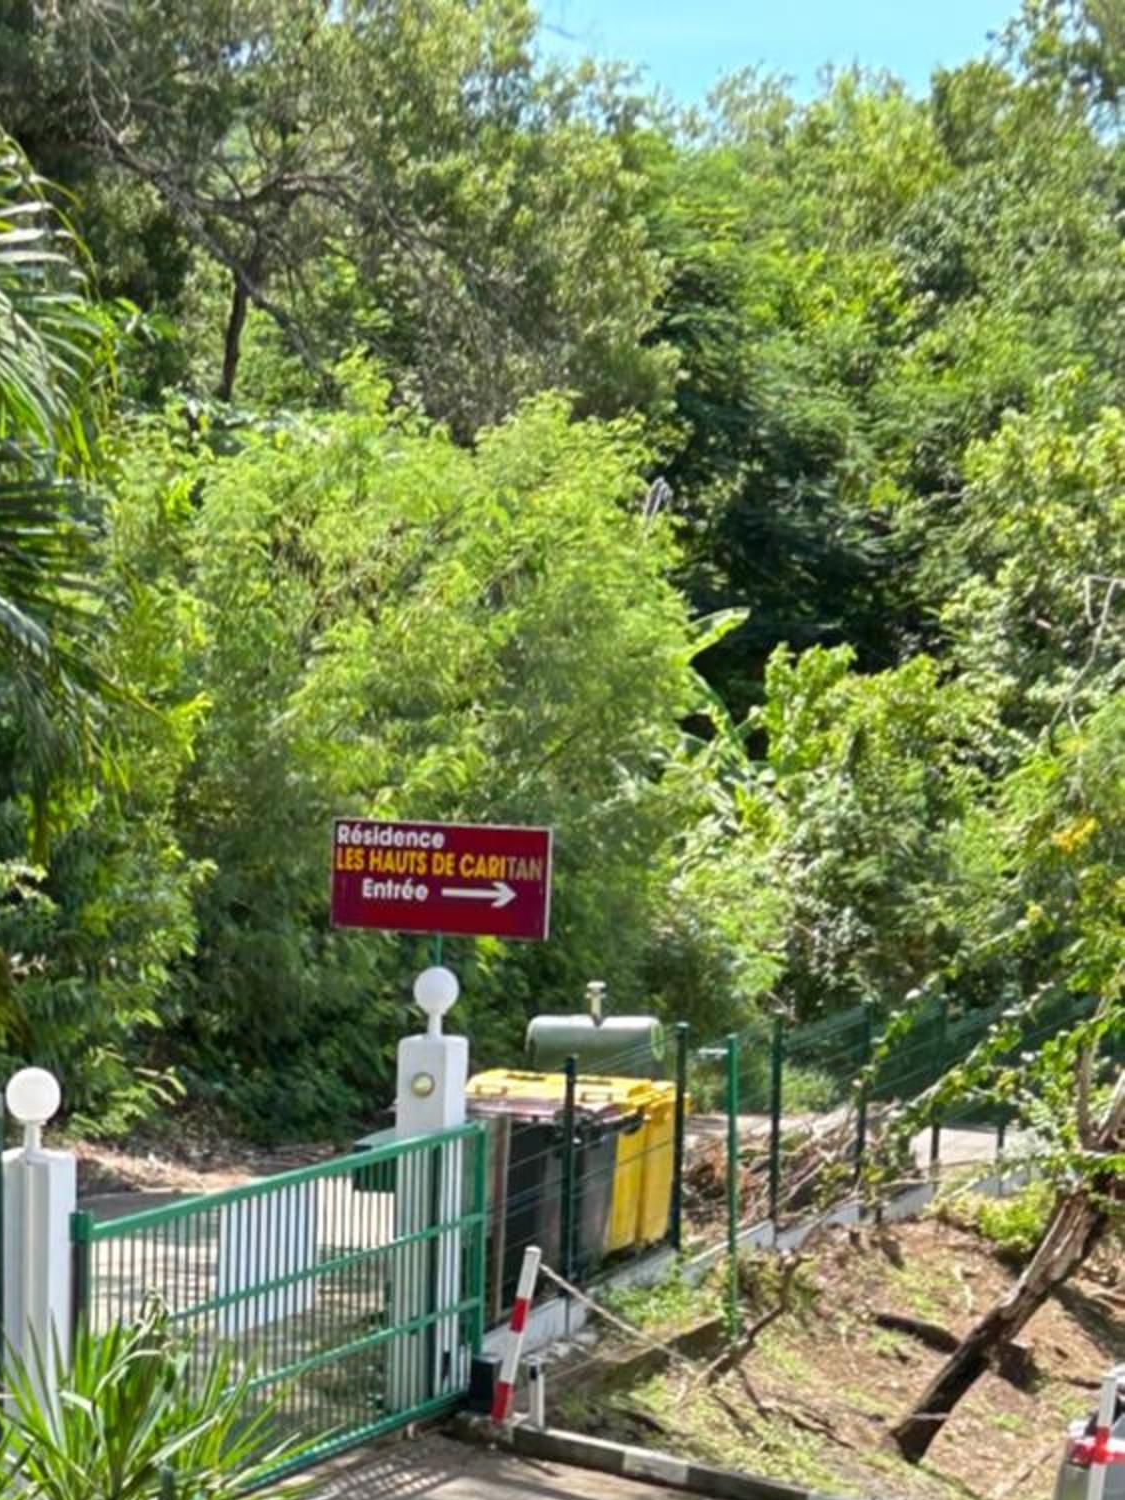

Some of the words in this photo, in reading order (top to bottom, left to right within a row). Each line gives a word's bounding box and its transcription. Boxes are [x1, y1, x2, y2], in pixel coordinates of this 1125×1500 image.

[337, 824, 445, 848] Résidence
[336, 847, 365, 871] LES
[369, 849, 427, 875] HAUTS
[432, 852, 455, 876] DE
[459, 854, 542, 880] CARITAN
[362, 878, 428, 901] Entrée
